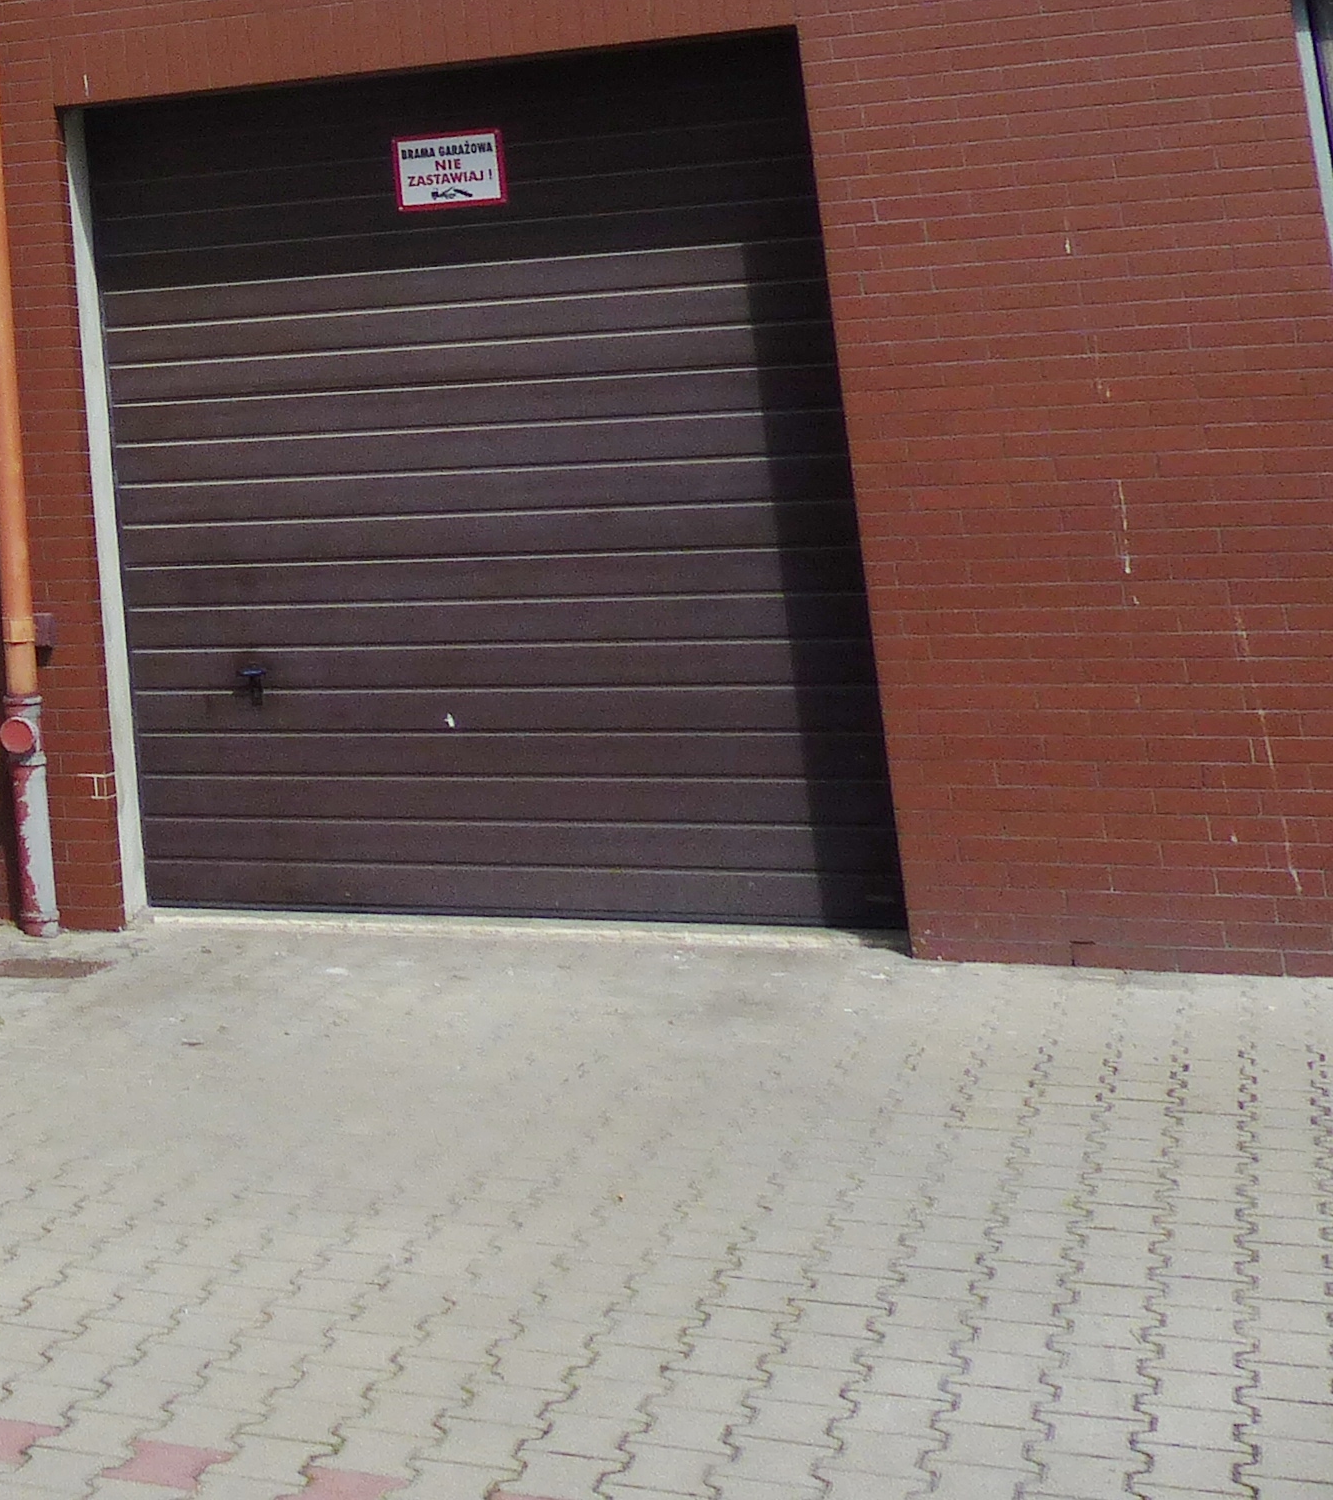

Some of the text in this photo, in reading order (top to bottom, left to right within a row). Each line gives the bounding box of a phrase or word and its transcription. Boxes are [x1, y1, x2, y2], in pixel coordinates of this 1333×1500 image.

[401, 141, 493, 160] BRAMA GARAŻOWA
[435, 159, 462, 171] NIE
[407, 170, 484, 187] ZASTAWIAJ
